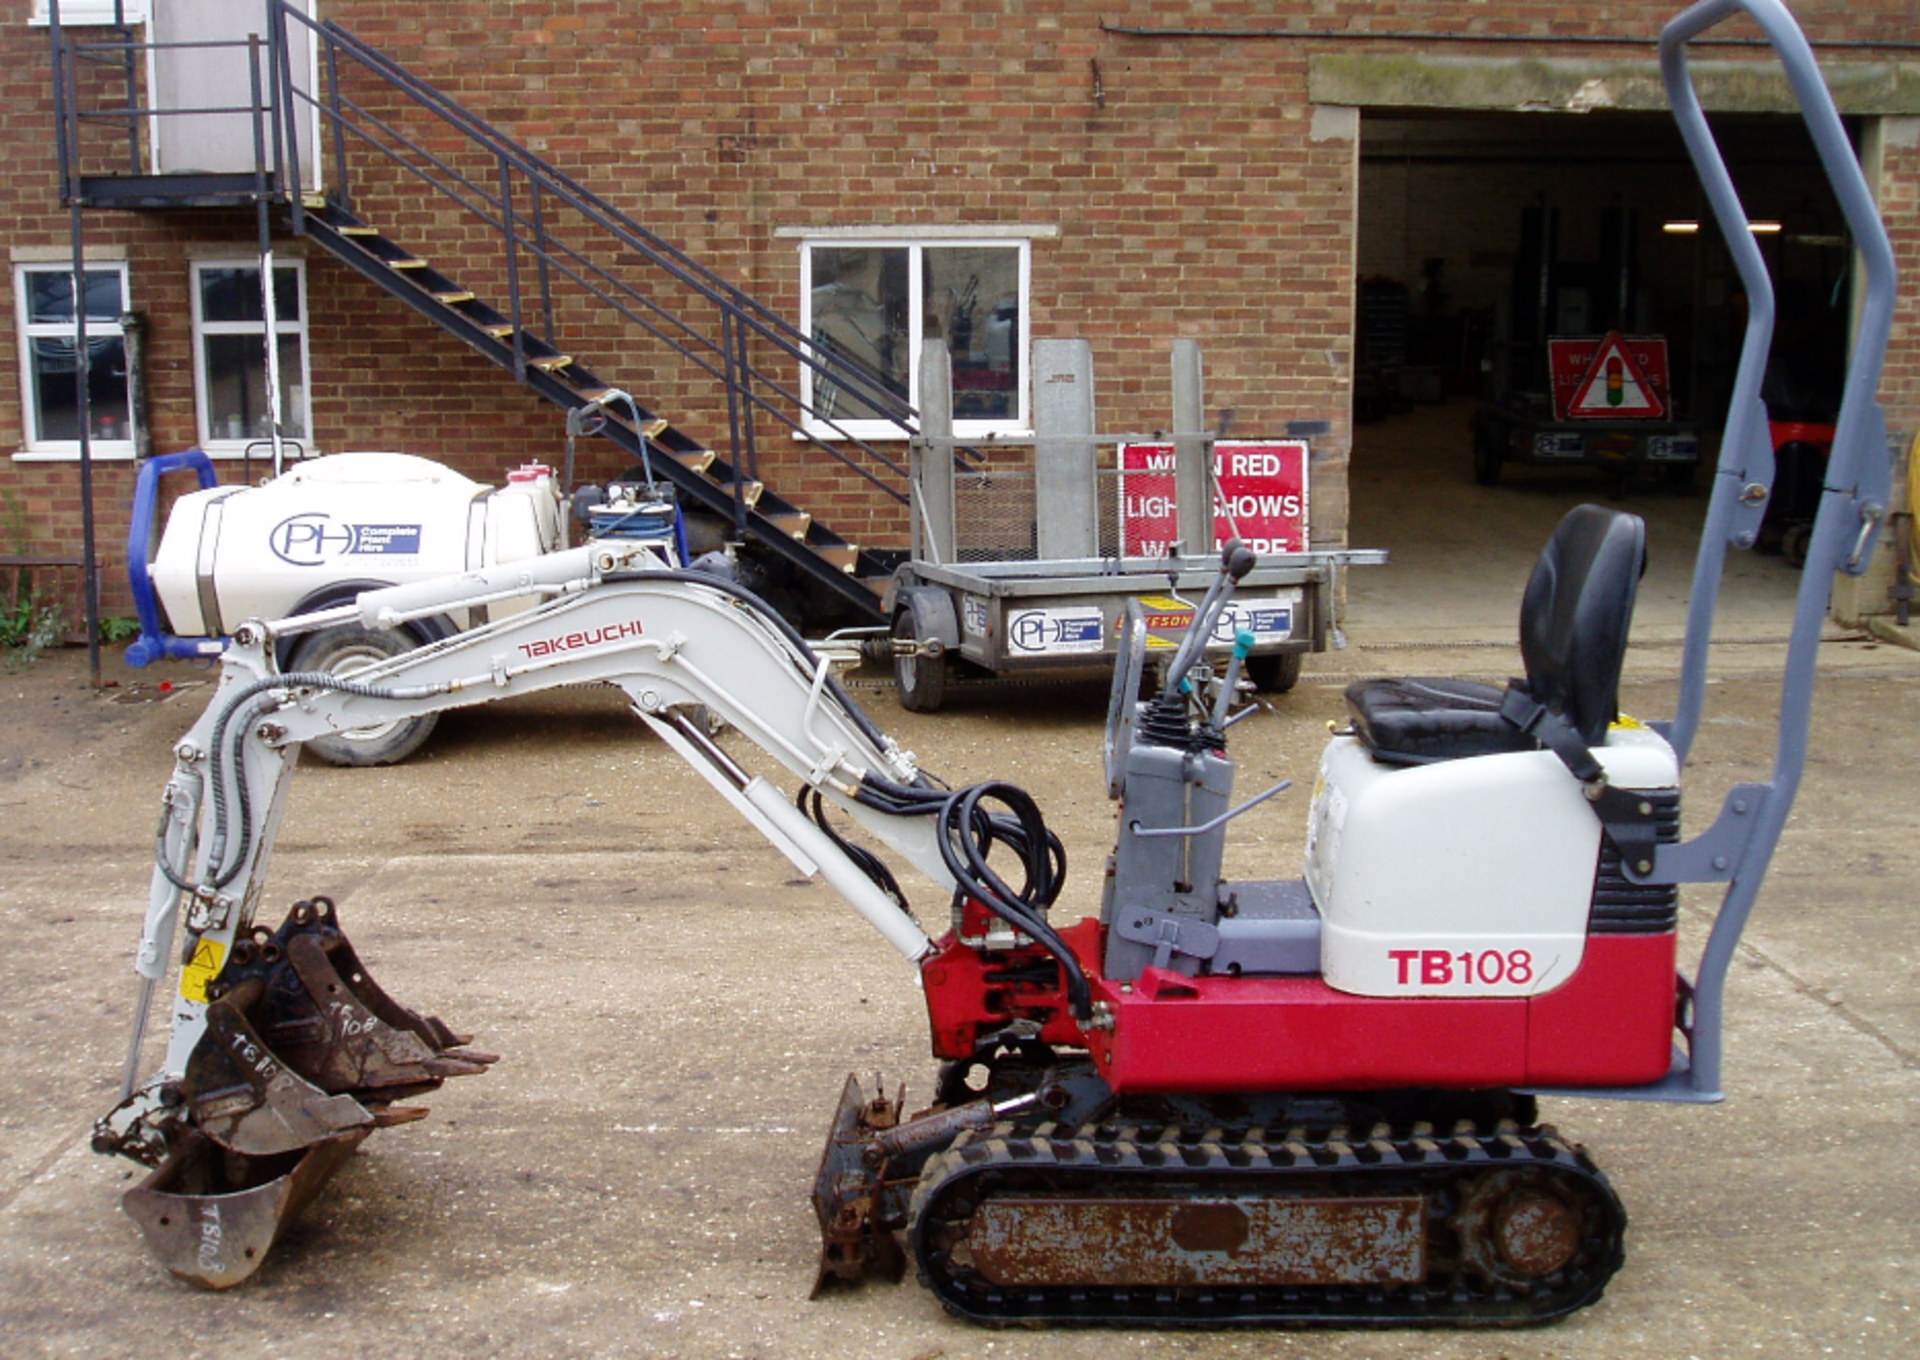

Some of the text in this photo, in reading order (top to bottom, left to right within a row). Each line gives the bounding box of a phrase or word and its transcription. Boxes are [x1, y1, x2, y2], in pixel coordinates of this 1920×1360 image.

[1232, 454, 1281, 476] RED
[360, 526, 418, 537] Complete
[360, 536, 392, 545] Plant
[360, 544, 384, 552] Hire
[1388, 949, 1533, 985] TB108
